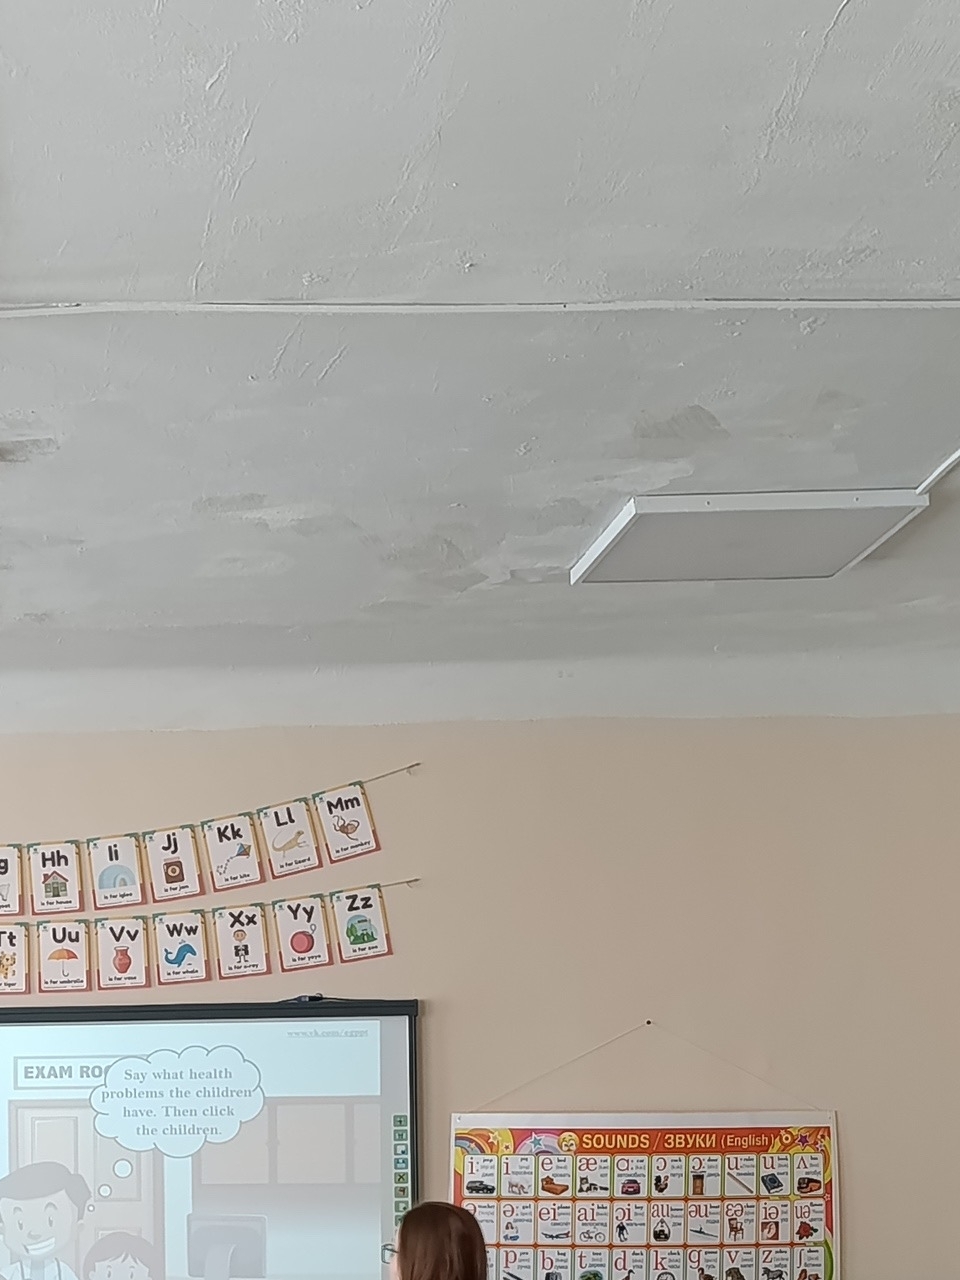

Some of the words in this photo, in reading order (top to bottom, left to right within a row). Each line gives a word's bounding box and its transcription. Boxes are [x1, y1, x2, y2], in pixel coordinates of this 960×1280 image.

[326, 796, 360, 814] Mm
[274, 807, 295, 827] Ll
[216, 823, 243, 842] Kk
[162, 832, 178, 854] Jj
[41, 850, 68, 868] Hh
[108, 844, 119, 862] Ii
[345, 894, 374, 912] Zz
[228, 910, 258, 928] Xx
[287, 904, 314, 923] Yy
[52, 927, 80, 943] Uu
[109, 926, 139, 942] Vv
[166, 922, 198, 938] Ww
[24, 1066, 72, 1079] EXAM
[124, 1068, 147, 1082] Say
[152, 1067, 185, 1080] what
[189, 1066, 233, 1080] health
[101, 1086, 164, 1102] problems
[169, 1086, 191, 1099] the
[196, 1085, 252, 1099] children
[122, 1105, 156, 1118] have.
[162, 1104, 198, 1118] Then
[202, 1104, 234, 1117] click
[136, 1124, 158, 1136] the
[162, 1123, 222, 1136] children.
[582, 1134, 650, 1149] SOUNDS
[664, 1133, 716, 1148] ЗВУКИ
[541, 1157, 553, 1171] e
[578, 1158, 598, 1172] æ
[538, 1203, 558, 1221] ei
[577, 1203, 596, 1221] ai
[652, 1204, 670, 1218] au
[504, 1250, 517, 1269] p
[541, 1251, 554, 1270] b
[578, 1251, 587, 1269] t
[614, 1250, 628, 1270] d
[653, 1250, 668, 1270] k
[726, 1250, 740, 1264] v
[762, 1250, 773, 1264] z
